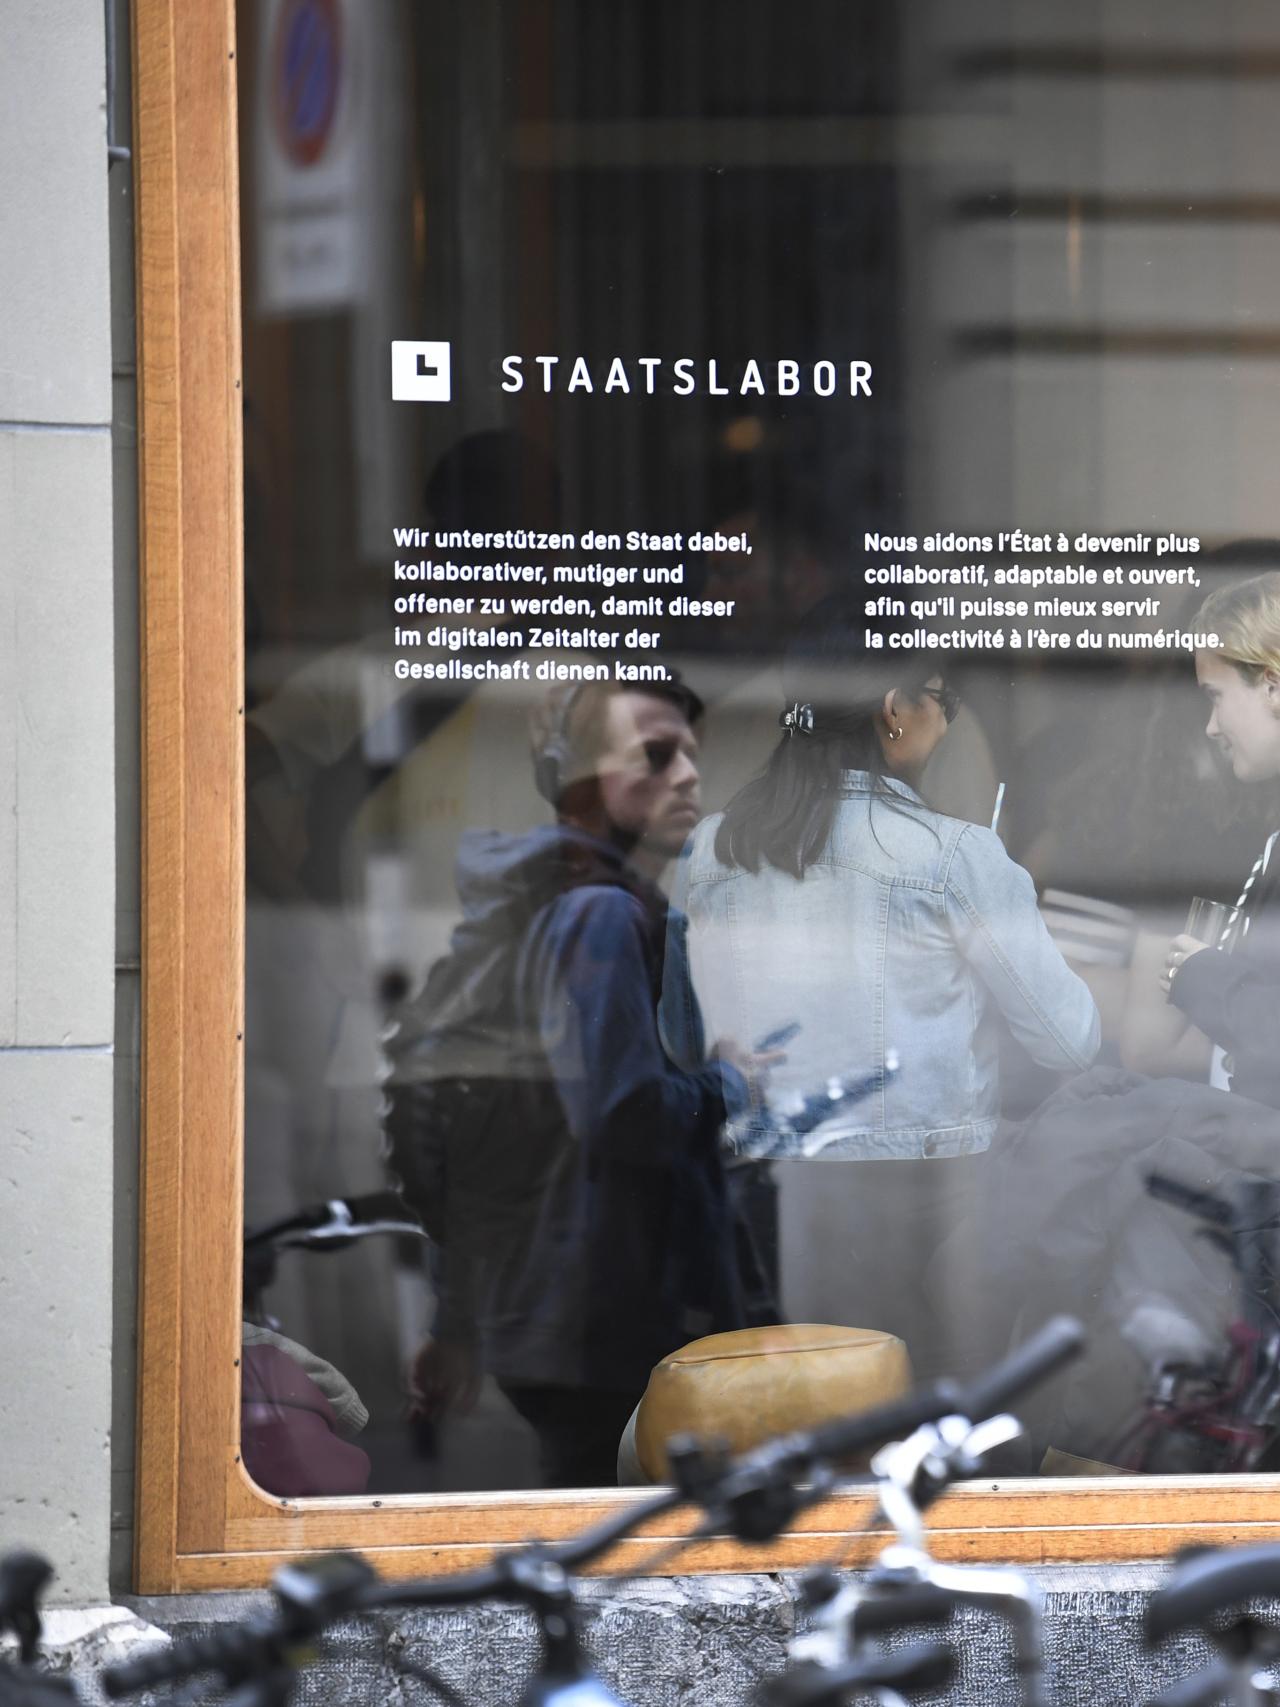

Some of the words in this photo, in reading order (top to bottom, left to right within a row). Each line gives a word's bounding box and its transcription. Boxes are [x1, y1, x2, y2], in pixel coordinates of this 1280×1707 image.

[501, 355, 872, 397] STAATSLABOR
[393, 528, 430, 547] Wir
[435, 530, 575, 550] unterstützen
[580, 530, 621, 550] den
[626, 531, 683, 551] Staat
[688, 531, 752, 555] dabei,
[864, 533, 918, 552] Nous
[923, 532, 993, 552] aidons
[1056, 532, 1069, 553] à
[1074, 533, 1152, 553] devenir
[1156, 533, 1200, 556] plus
[394, 560, 547, 585] kollaborativer,
[553, 563, 638, 587] mutiger
[643, 564, 683, 584] und
[864, 564, 989, 587] collaboratif,
[993, 564, 1098, 588] adaptable
[1102, 566, 1124, 585] et
[1128, 566, 1201, 588] ouvert,
[394, 593, 475, 614] offener
[480, 598, 505, 614] zu
[510, 595, 596, 618] werden,
[601, 595, 663, 616] damit
[668, 596, 735, 617] dieser
[864, 596, 905, 616] afin
[910, 596, 955, 620] qu'il
[960, 597, 1029, 620] puisse
[1034, 597, 1097, 617] mieux
[1101, 597, 1161, 617] servir
[395, 626, 421, 646] im
[427, 626, 523, 651] digitalen
[528, 628, 620, 648] Zeitalter
[624, 628, 660, 648] der
[865, 628, 883, 649] la
[888, 628, 1005, 649] collectivité
[1009, 628, 1022, 649] à
[1076, 629, 1102, 649] du
[1108, 628, 1225, 652] numérique.
[394, 659, 530, 680] Gesellschaft
[535, 660, 609, 681] dienen
[615, 661, 672, 681] kann.
